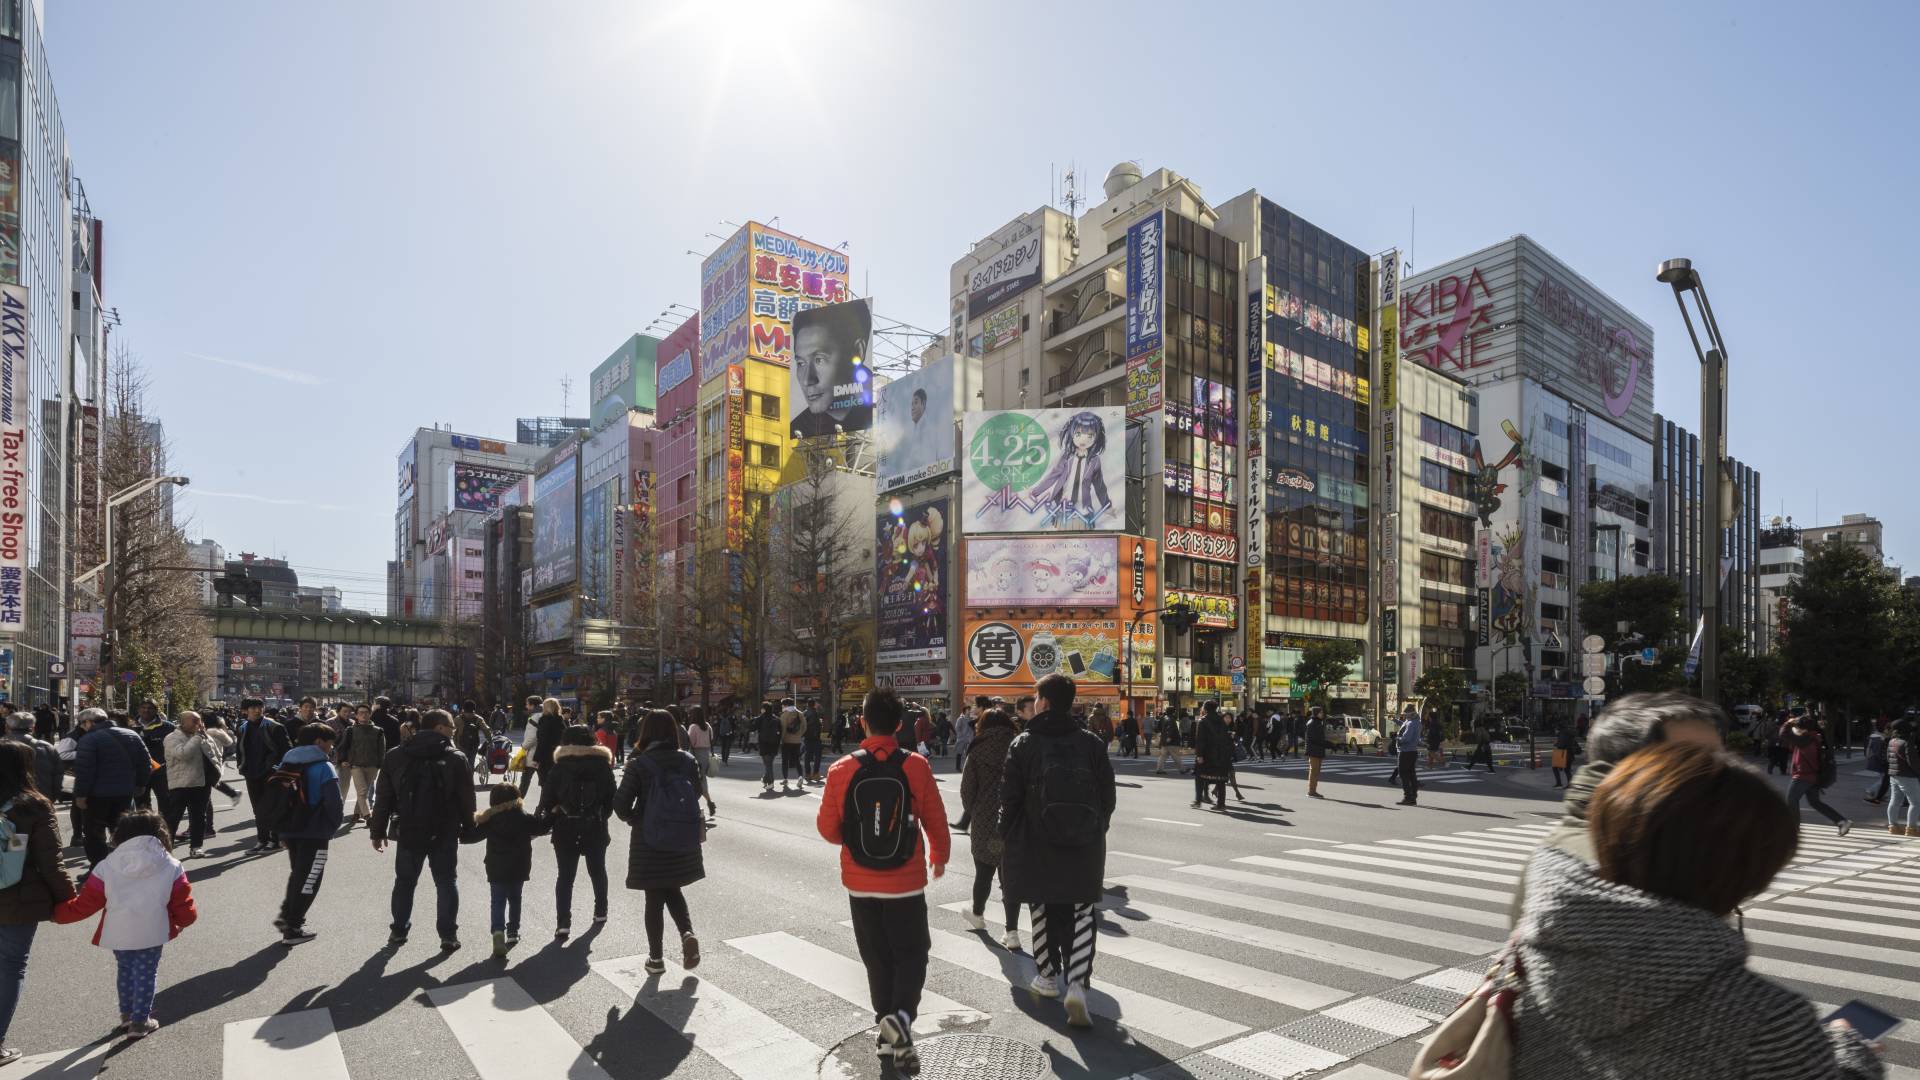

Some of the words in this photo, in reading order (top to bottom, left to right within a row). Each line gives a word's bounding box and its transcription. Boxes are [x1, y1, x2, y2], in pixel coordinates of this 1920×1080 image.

[753, 231, 848, 274] MEDIAリサイクル
[754, 254, 846, 305] 激安販売
[2, 291, 25, 360] AKKY
[1383, 328, 1391, 354] Yellow
[2, 339, 13, 426] INTERNATIONAL
[833, 383, 864, 397] DMM
[1383, 361, 1392, 406] Submarine
[1178, 416, 1192, 431] 6F
[2, 429, 24, 508] Tax-free
[971, 434, 1047, 467] 4.25
[1001, 466, 1022, 475] ON
[992, 474, 1031, 483] SALE
[1178, 477, 1192, 493] 5F
[1, 511, 24, 560] Shop
[1168, 529, 1237, 558] メイドカジノ
[615, 547, 624, 592] Tax-free
[0, 566, 21, 624] 愛客本店
[1480, 590, 1488, 644] GALLERIA
[974, 632, 1017, 671] 質
[895, 675, 919, 686] COMIC
[919, 674, 931, 685] ZIN
